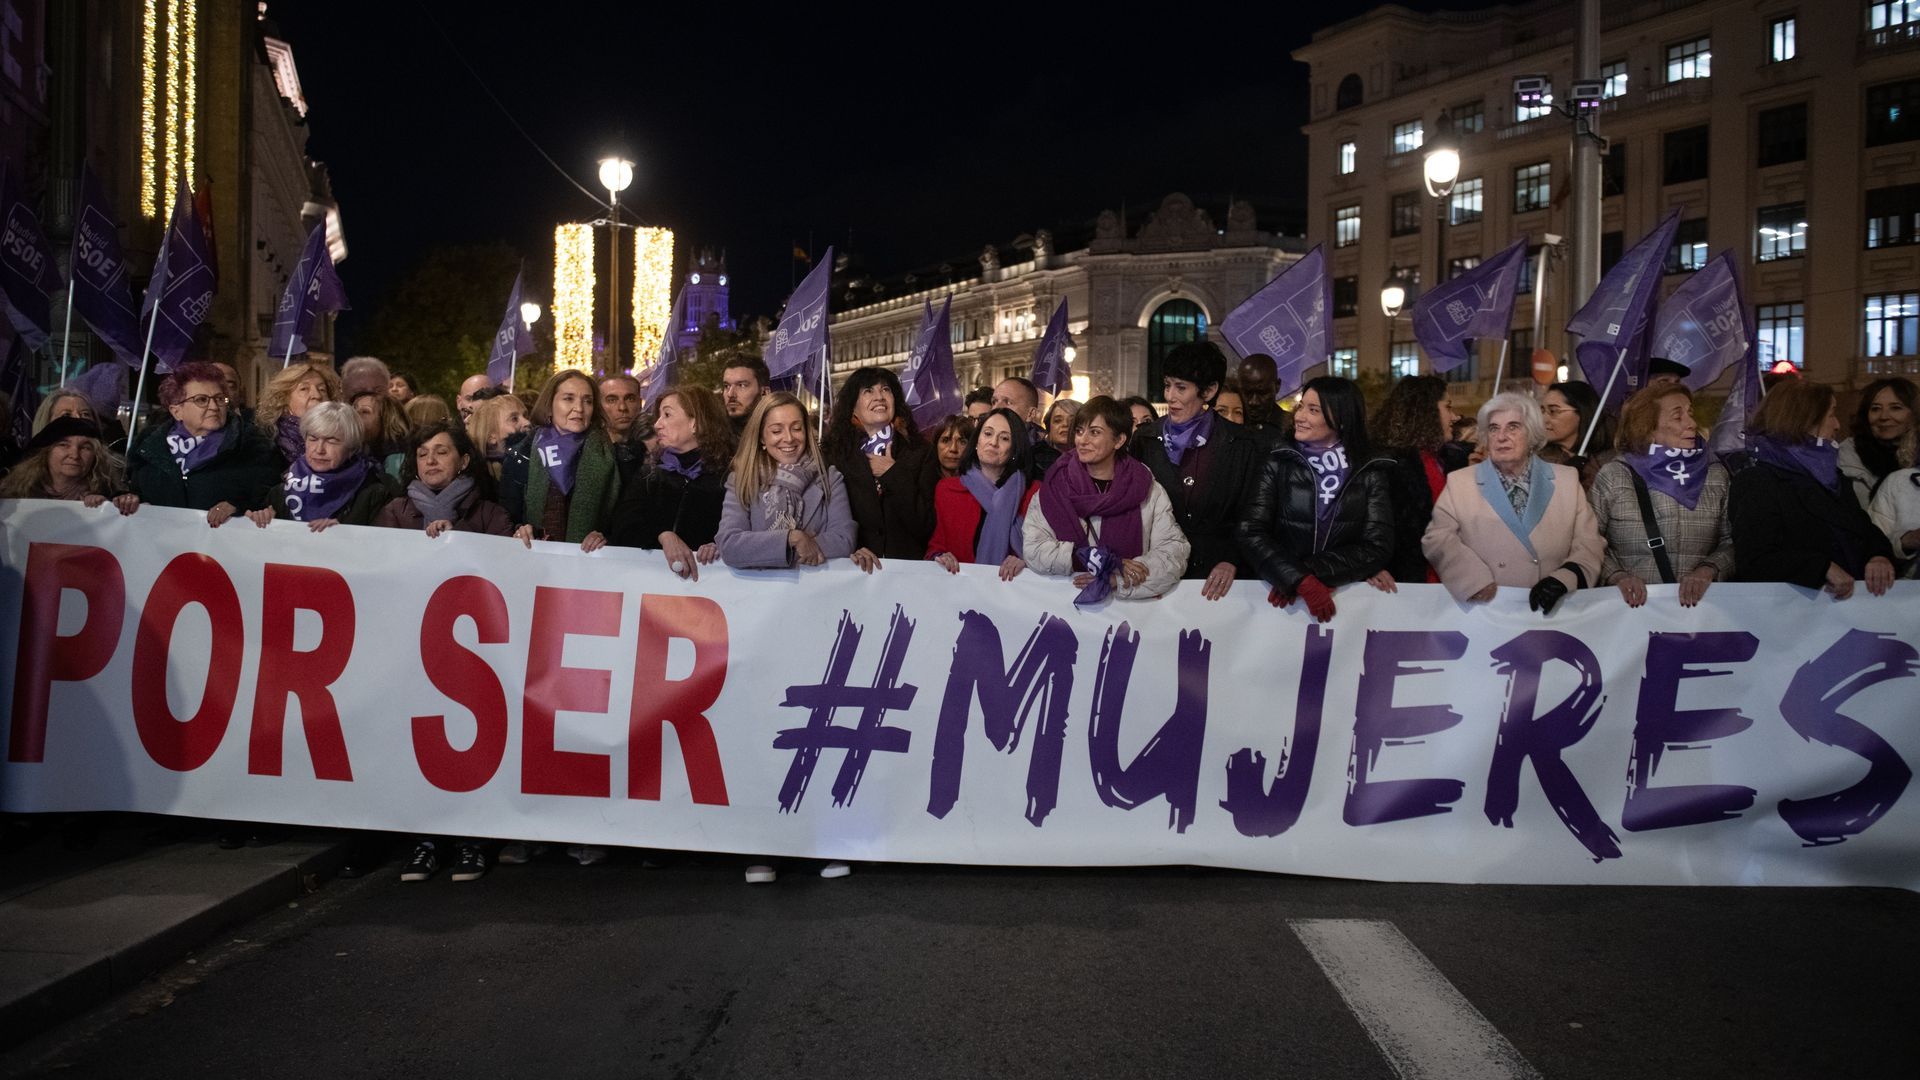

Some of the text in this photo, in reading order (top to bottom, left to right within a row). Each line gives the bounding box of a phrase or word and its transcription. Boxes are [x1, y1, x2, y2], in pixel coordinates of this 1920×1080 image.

[3, 229, 43, 271] PSOE
[81, 221, 109, 249] Madrid
[8, 542, 1920, 864] POR SER #MUJERES
